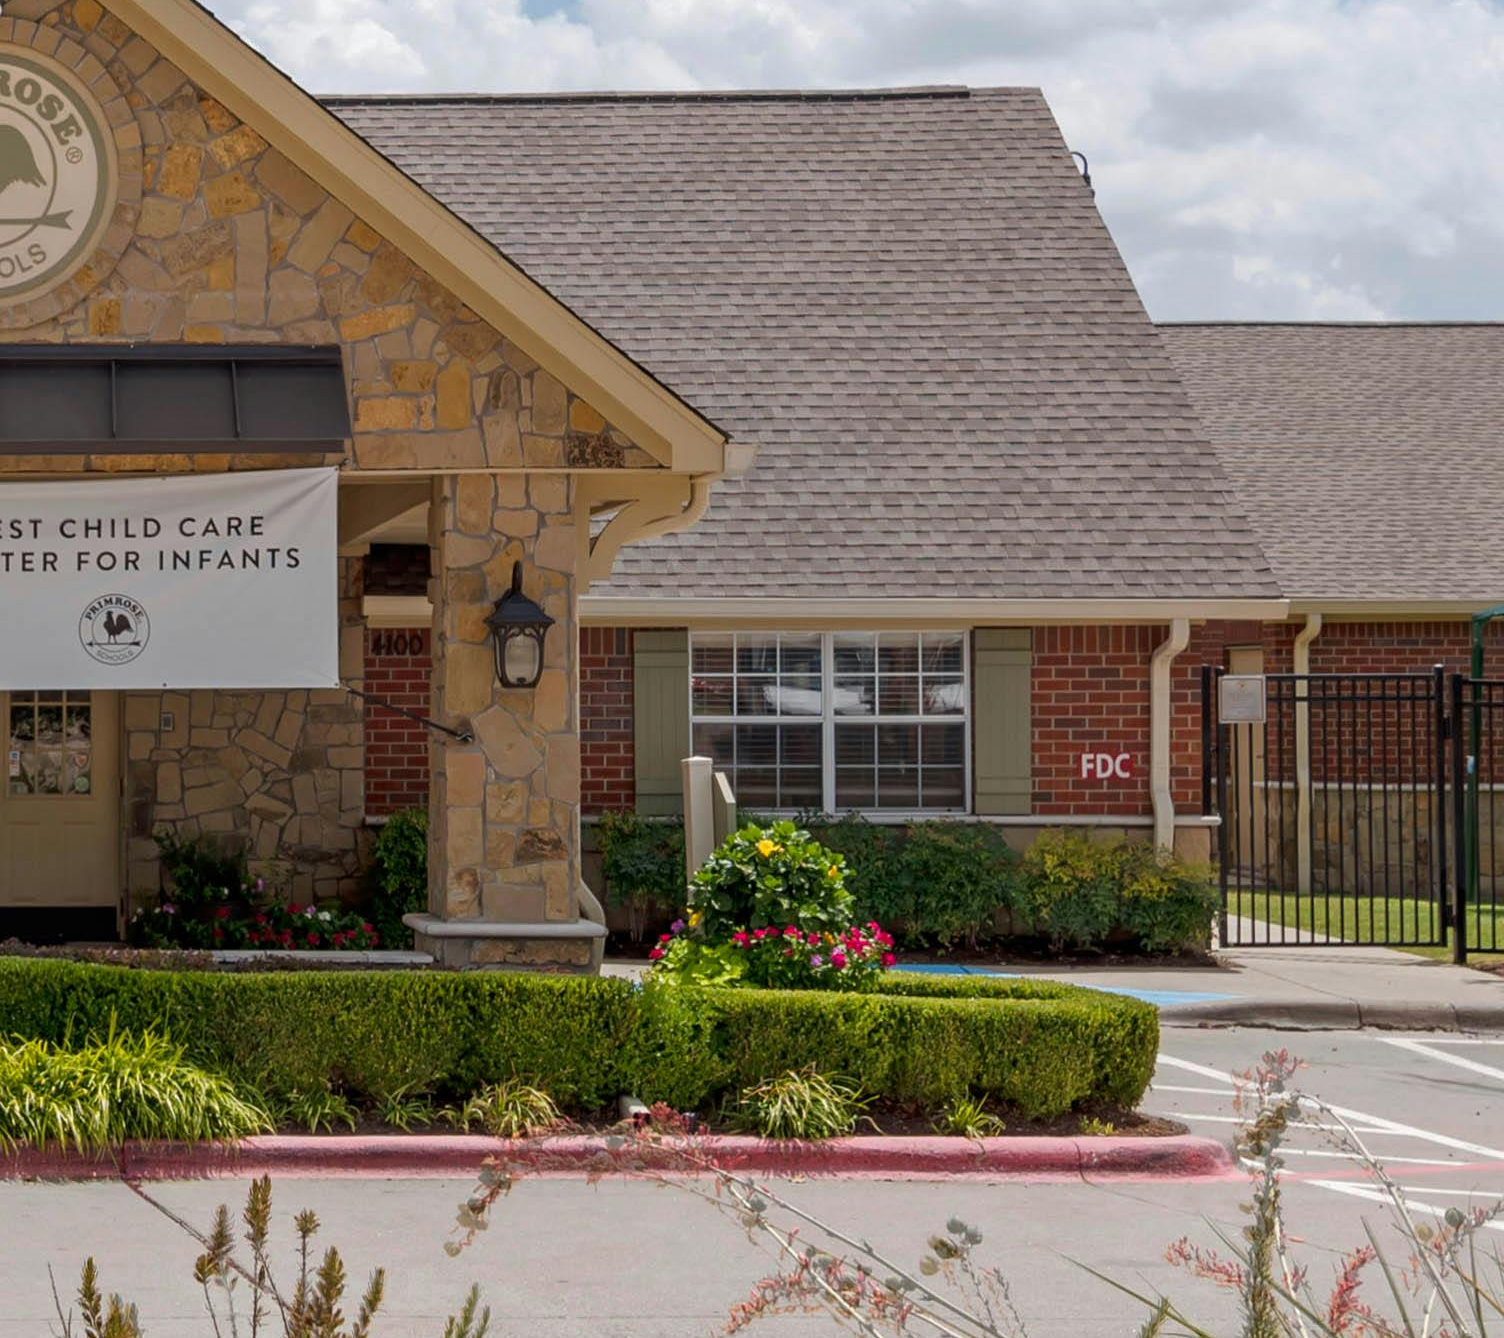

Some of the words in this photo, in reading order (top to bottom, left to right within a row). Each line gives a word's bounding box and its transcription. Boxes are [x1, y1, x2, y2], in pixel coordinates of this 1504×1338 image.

[59, 518, 161, 539] CHILD
[179, 516, 265, 537] CARE
[77, 551, 140, 572] FOR
[159, 548, 300, 571] INFANTS
[85, 597, 144, 620] PRIMROSE
[1081, 753, 1131, 779] FDC
